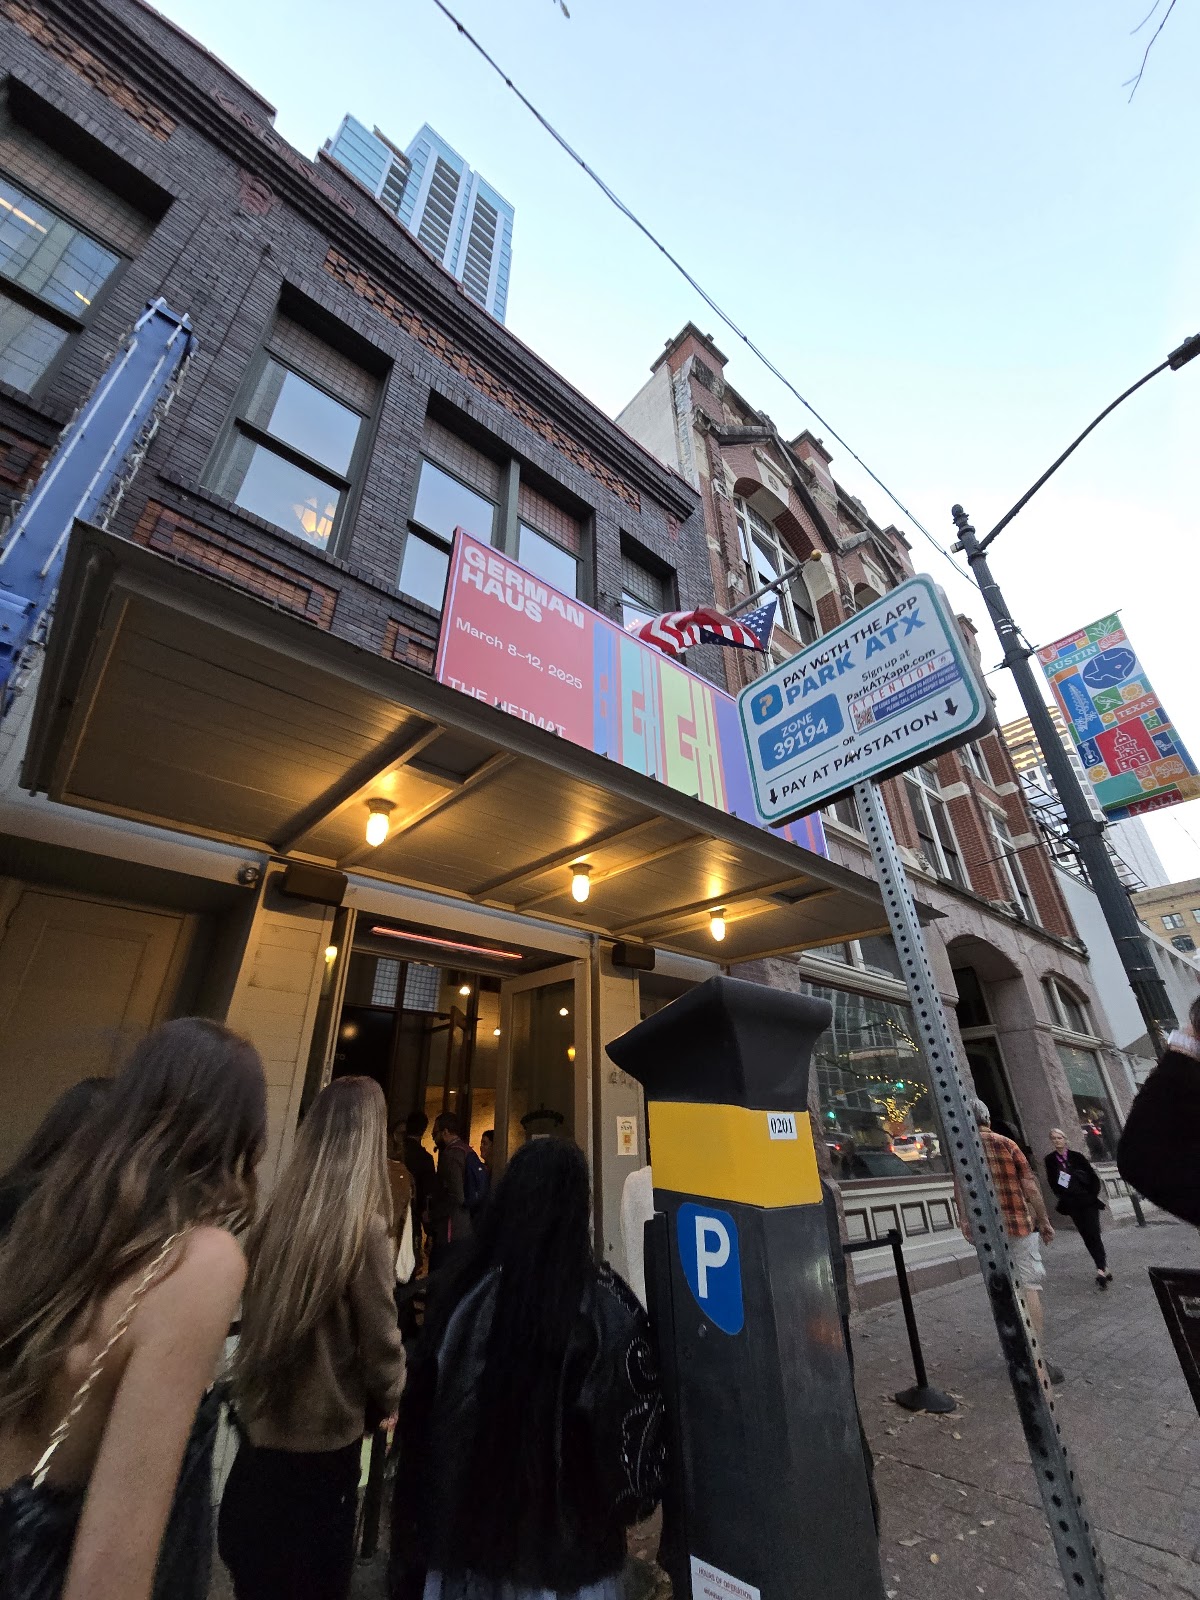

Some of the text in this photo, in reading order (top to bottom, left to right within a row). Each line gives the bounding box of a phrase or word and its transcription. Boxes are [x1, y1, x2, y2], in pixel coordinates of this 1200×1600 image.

[461, 565, 543, 623] HAUS
[464, 545, 585, 629] GERMAN
[456, 617, 503, 650] March
[548, 664, 583, 690] 2025
[783, 664, 807, 689] PAY
[850, 618, 882, 644] THE
[885, 596, 917, 625] APP
[785, 650, 856, 706] PARK
[865, 608, 926, 660] ATX
[861, 649, 911, 682] Sign up at
[1047, 645, 1097, 675] AUSTIN
[846, 648, 936, 703] ParkATXapp.com
[781, 712, 813, 737] ZONE
[1117, 698, 1155, 719] TEXAS
[774, 718, 828, 760] 39194
[782, 710, 939, 797] PAY AT PAYSTATION
[843, 736, 856, 746] OR
[770, 1117, 793, 1134] 0201
[695, 1215, 731, 1299] P
